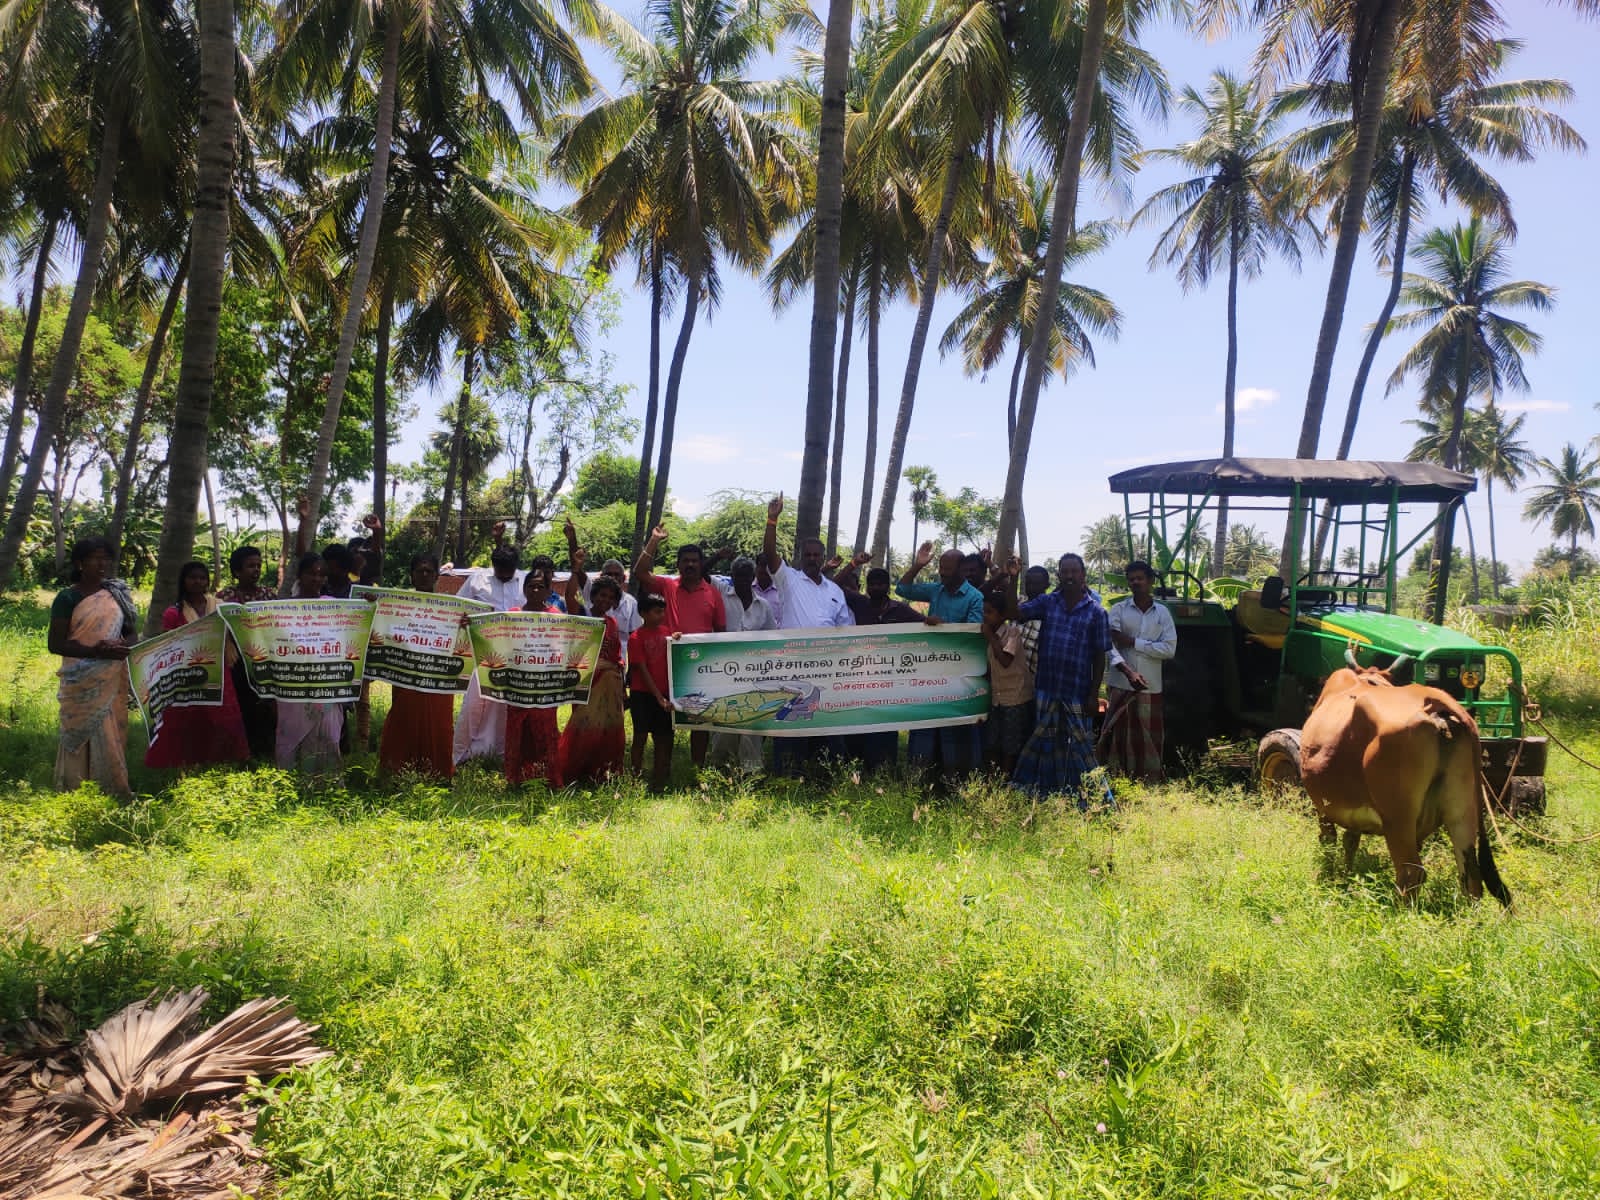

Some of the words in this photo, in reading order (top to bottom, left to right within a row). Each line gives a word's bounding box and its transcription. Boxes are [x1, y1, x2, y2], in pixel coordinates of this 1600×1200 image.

[697, 661, 740, 676] எட்டு
[745, 659, 834, 675] வழிச்சாலை
[838, 654, 895, 670] எதிர்ப்பு
[900, 652, 961, 667] இயக்கம்
[832, 681, 894, 692] சென்னை
[909, 678, 949, 687] சேலம்
